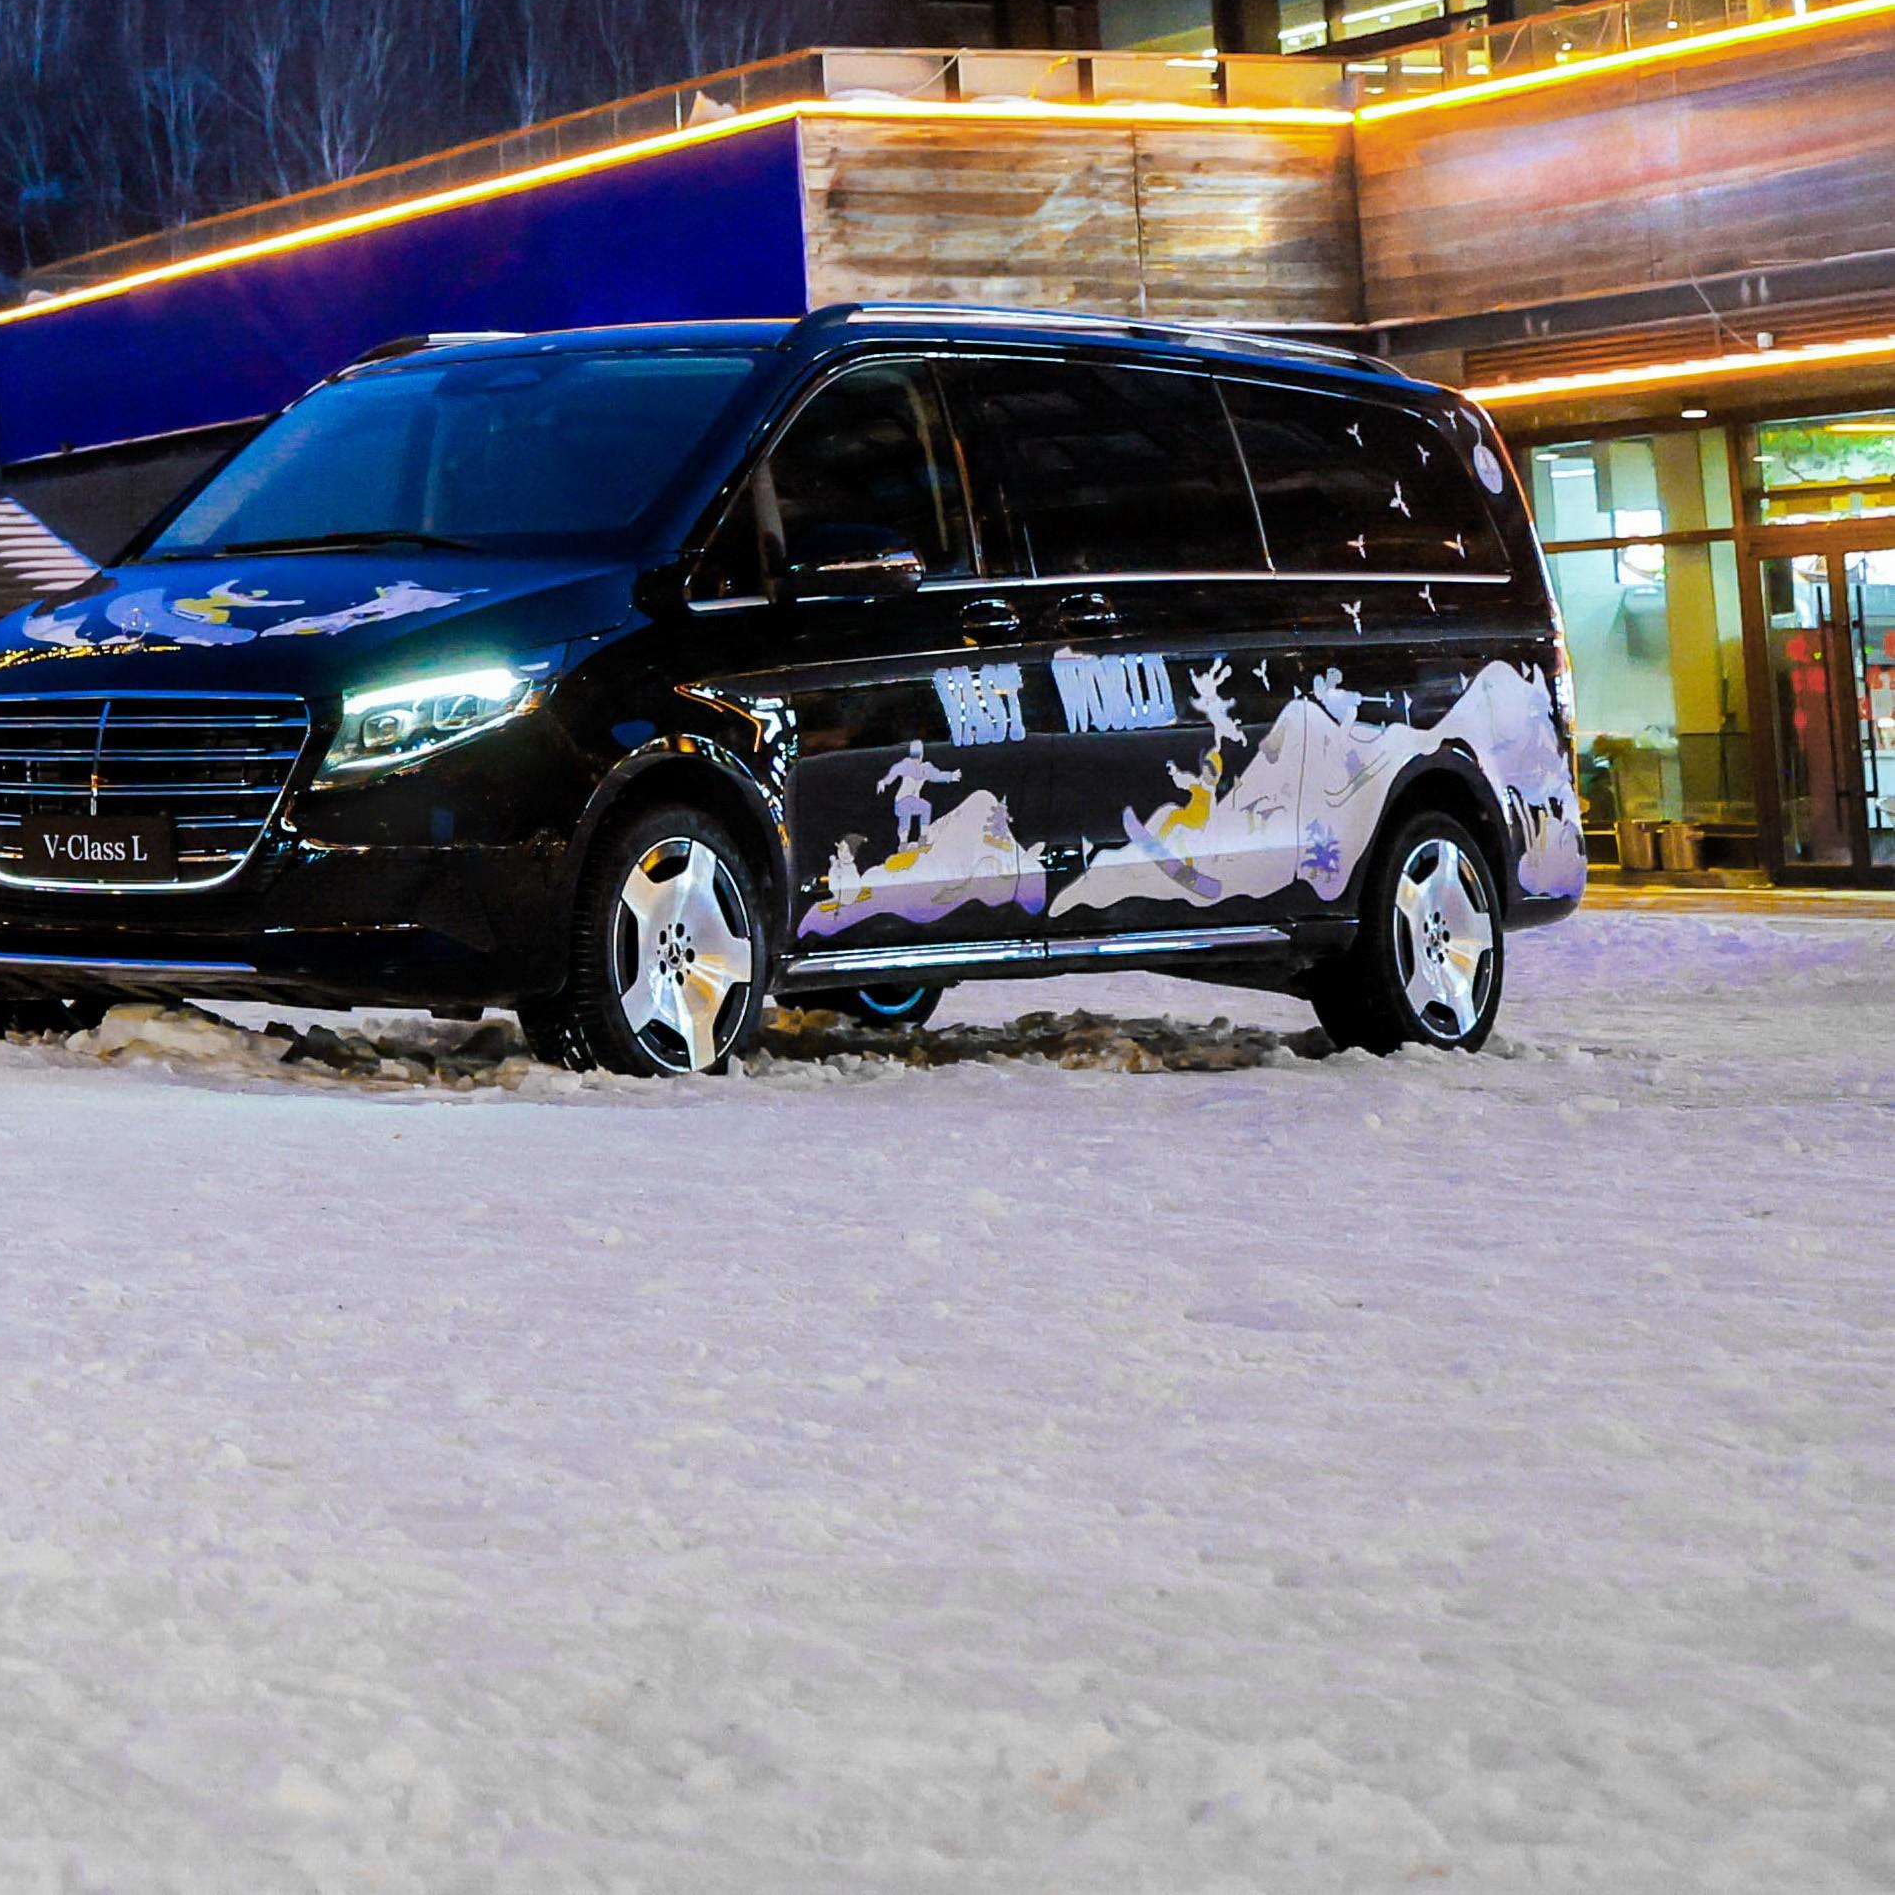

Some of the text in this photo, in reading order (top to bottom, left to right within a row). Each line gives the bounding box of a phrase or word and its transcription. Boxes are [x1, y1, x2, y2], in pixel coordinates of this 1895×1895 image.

[931, 661, 1027, 747] VAST
[42, 834, 148, 862] V-Class L
